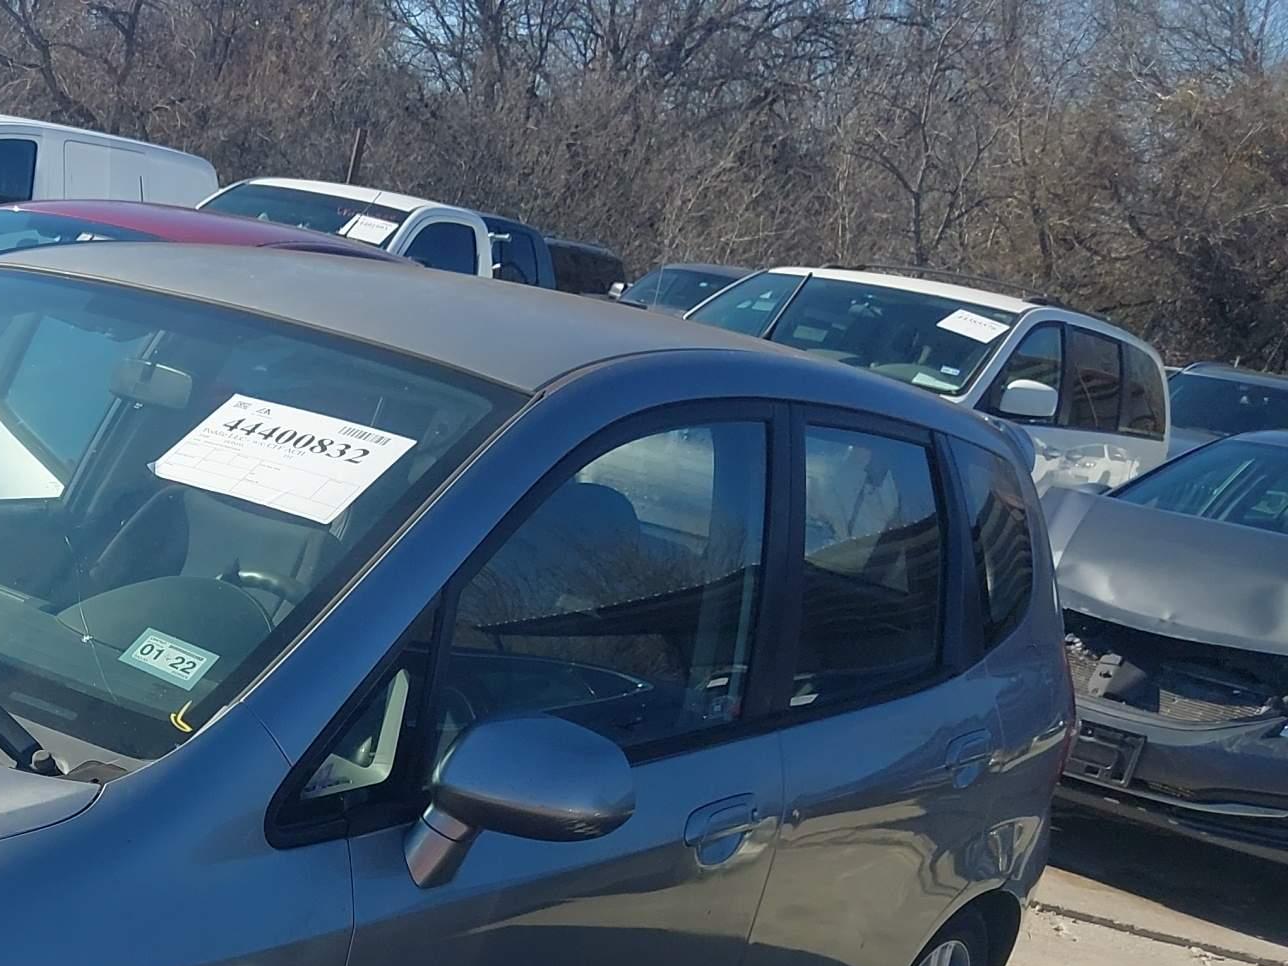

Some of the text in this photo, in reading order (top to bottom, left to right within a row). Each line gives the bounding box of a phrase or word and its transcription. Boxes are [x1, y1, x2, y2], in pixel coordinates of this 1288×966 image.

[223, 417, 370, 464] 44400832
[139, 643, 165, 660] 01
[168, 656, 197, 675] 22
